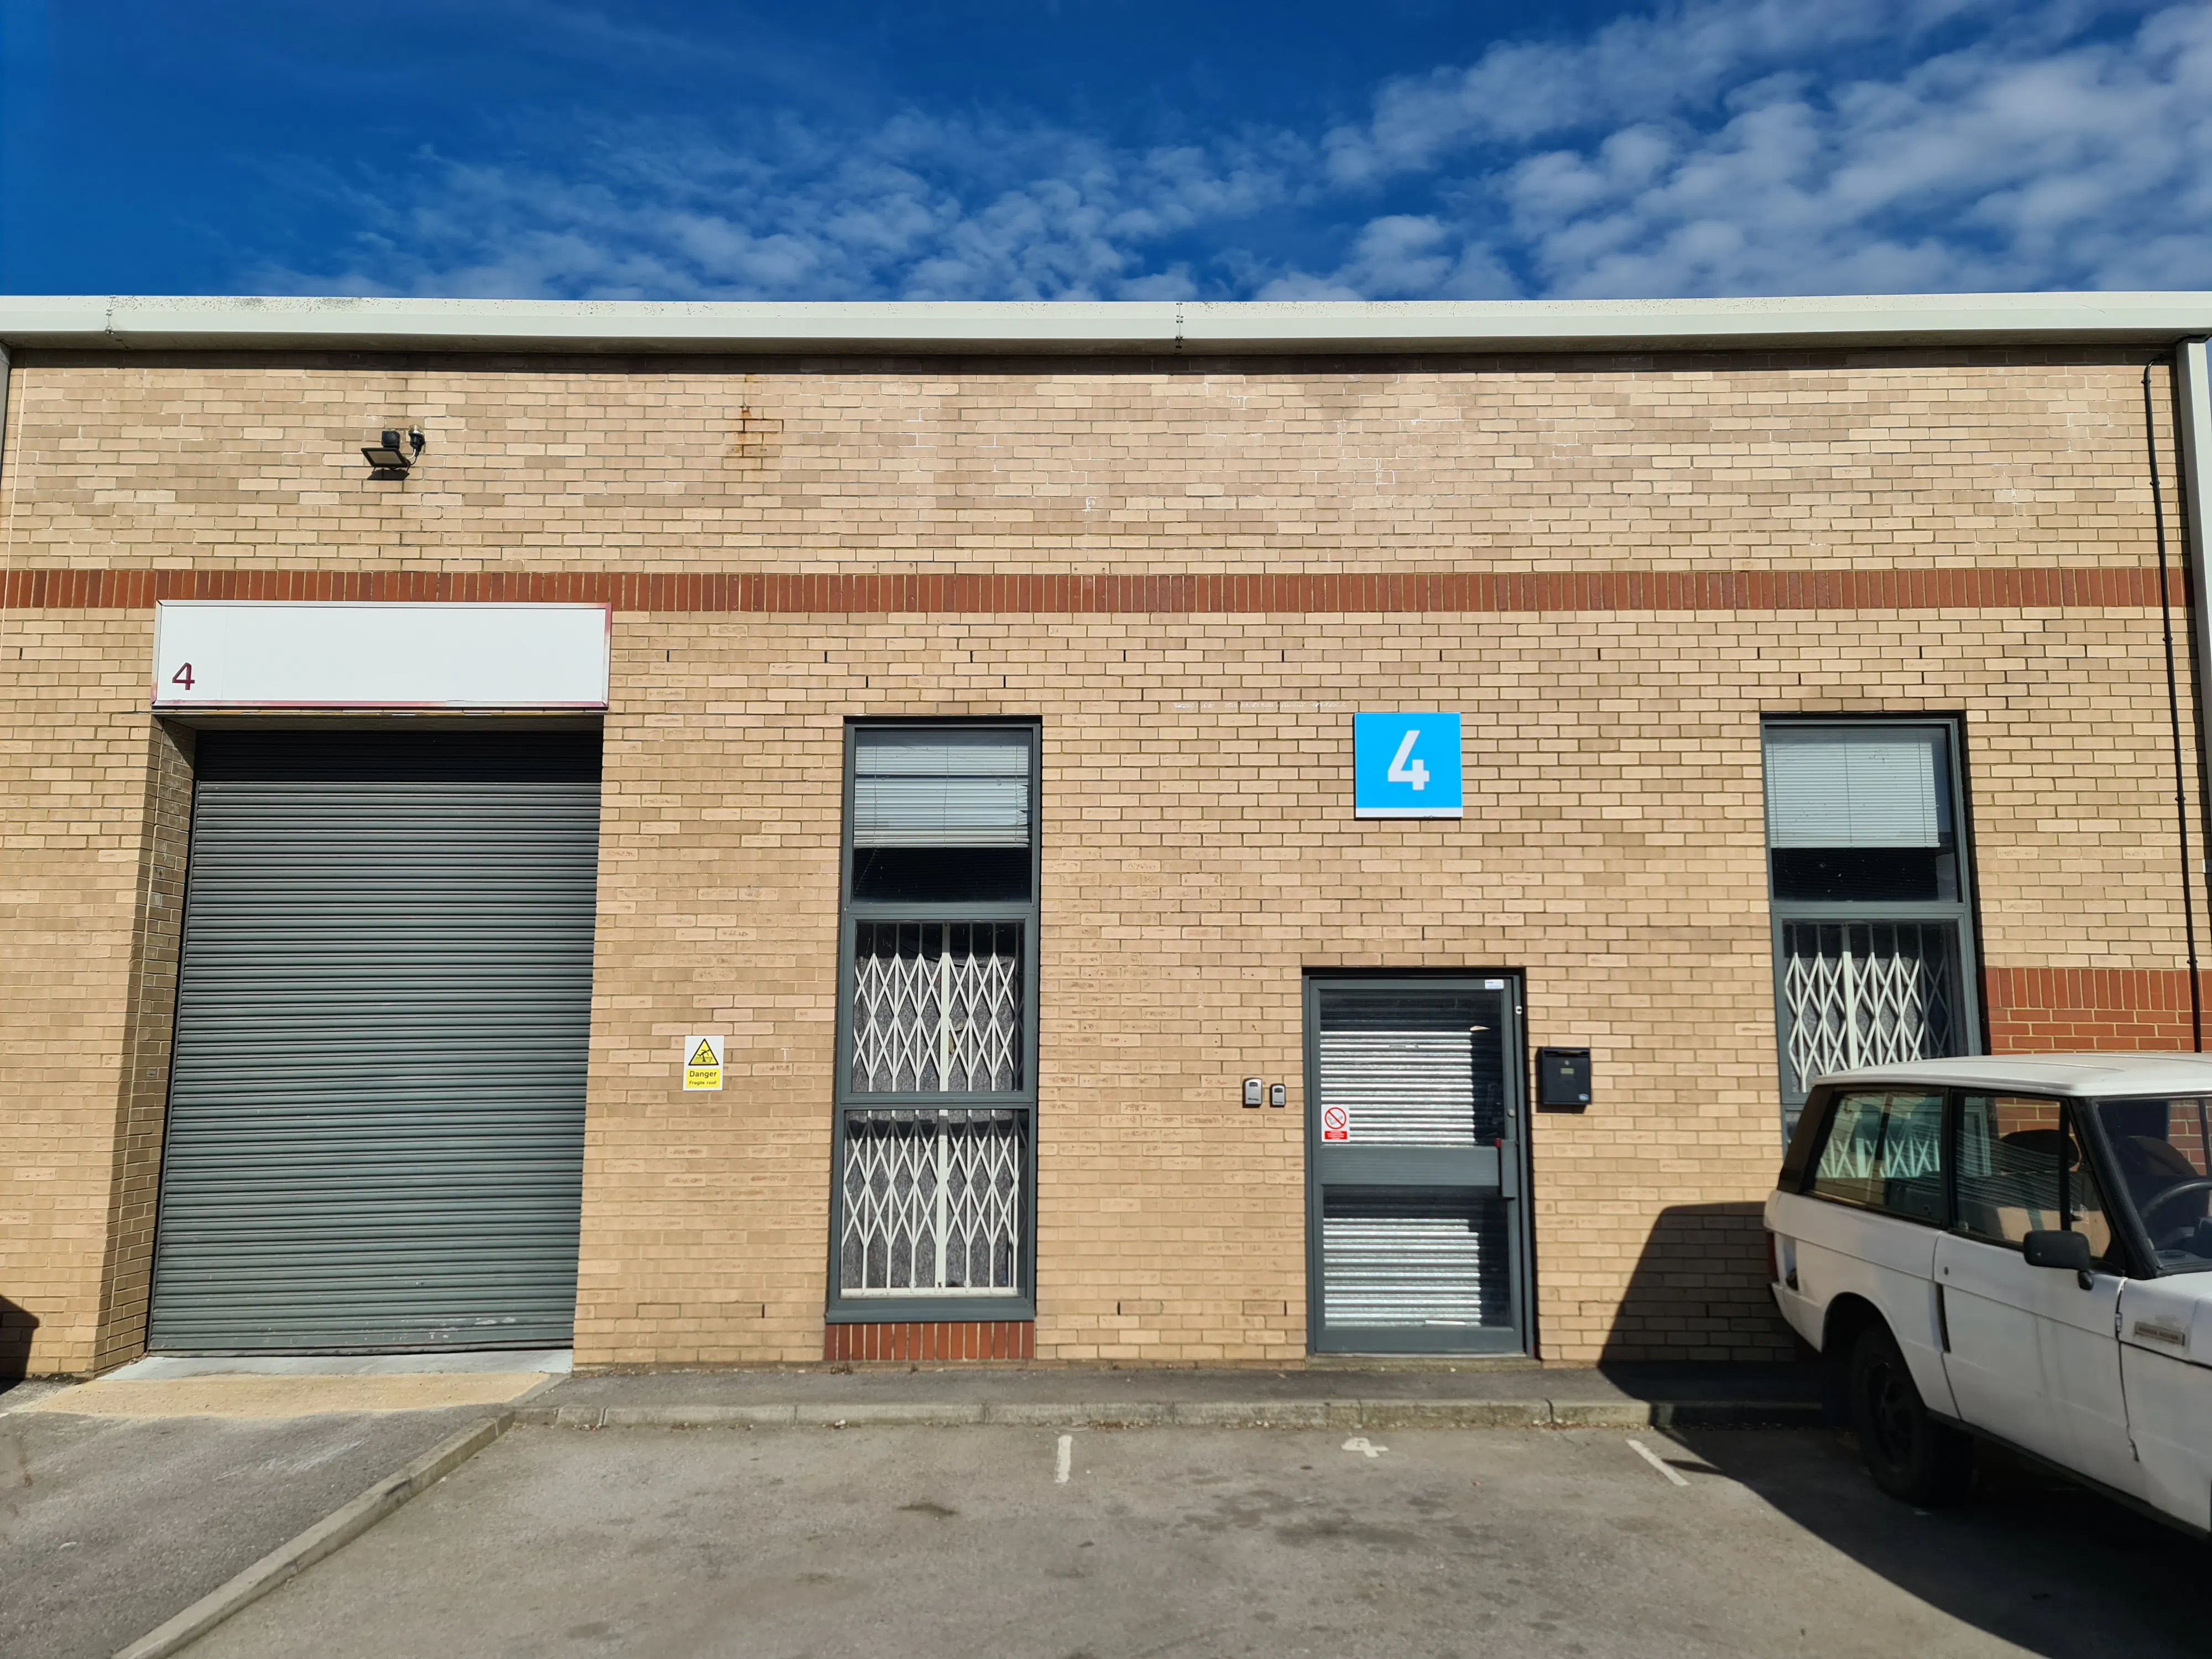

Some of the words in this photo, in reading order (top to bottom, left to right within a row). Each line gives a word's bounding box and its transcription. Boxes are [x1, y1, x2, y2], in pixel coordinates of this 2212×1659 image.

[172, 662, 195, 691] 4
[1387, 729, 1430, 791] 4
[690, 1071, 717, 1079] Danger
